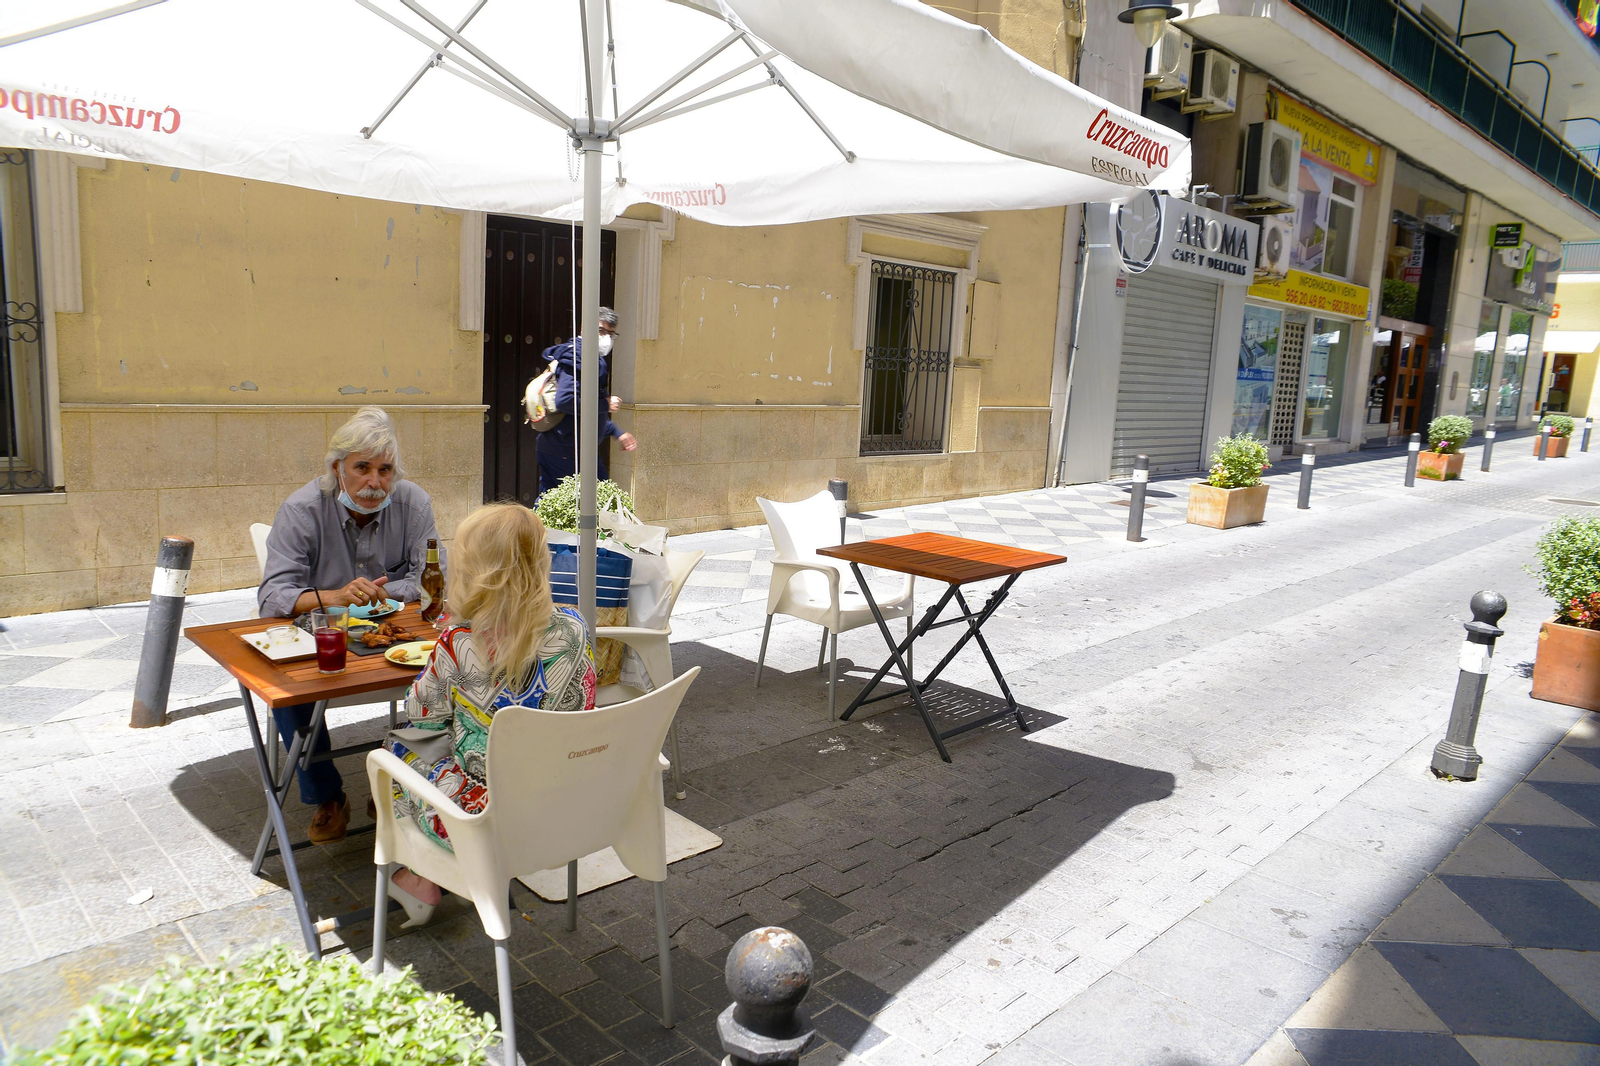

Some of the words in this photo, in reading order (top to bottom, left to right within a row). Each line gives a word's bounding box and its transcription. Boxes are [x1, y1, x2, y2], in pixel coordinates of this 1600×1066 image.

[1283, 104, 1301, 119] NUEVA
[1087, 107, 1169, 169] Cruzcampo
[1311, 135, 1323, 156] LA
[1325, 141, 1351, 170] VENTA
[1175, 212, 1249, 261] AROMA
[1198, 254, 1205, 266] Y
[1207, 257, 1247, 276] DELICIAS
[1286, 288, 1298, 303] 956
[1299, 291, 1308, 305] 20
[1299, 276, 1336, 294] INFORMACIÓN
[1342, 286, 1357, 298] VENTA
[567, 743, 610, 759] Cruzcampo
